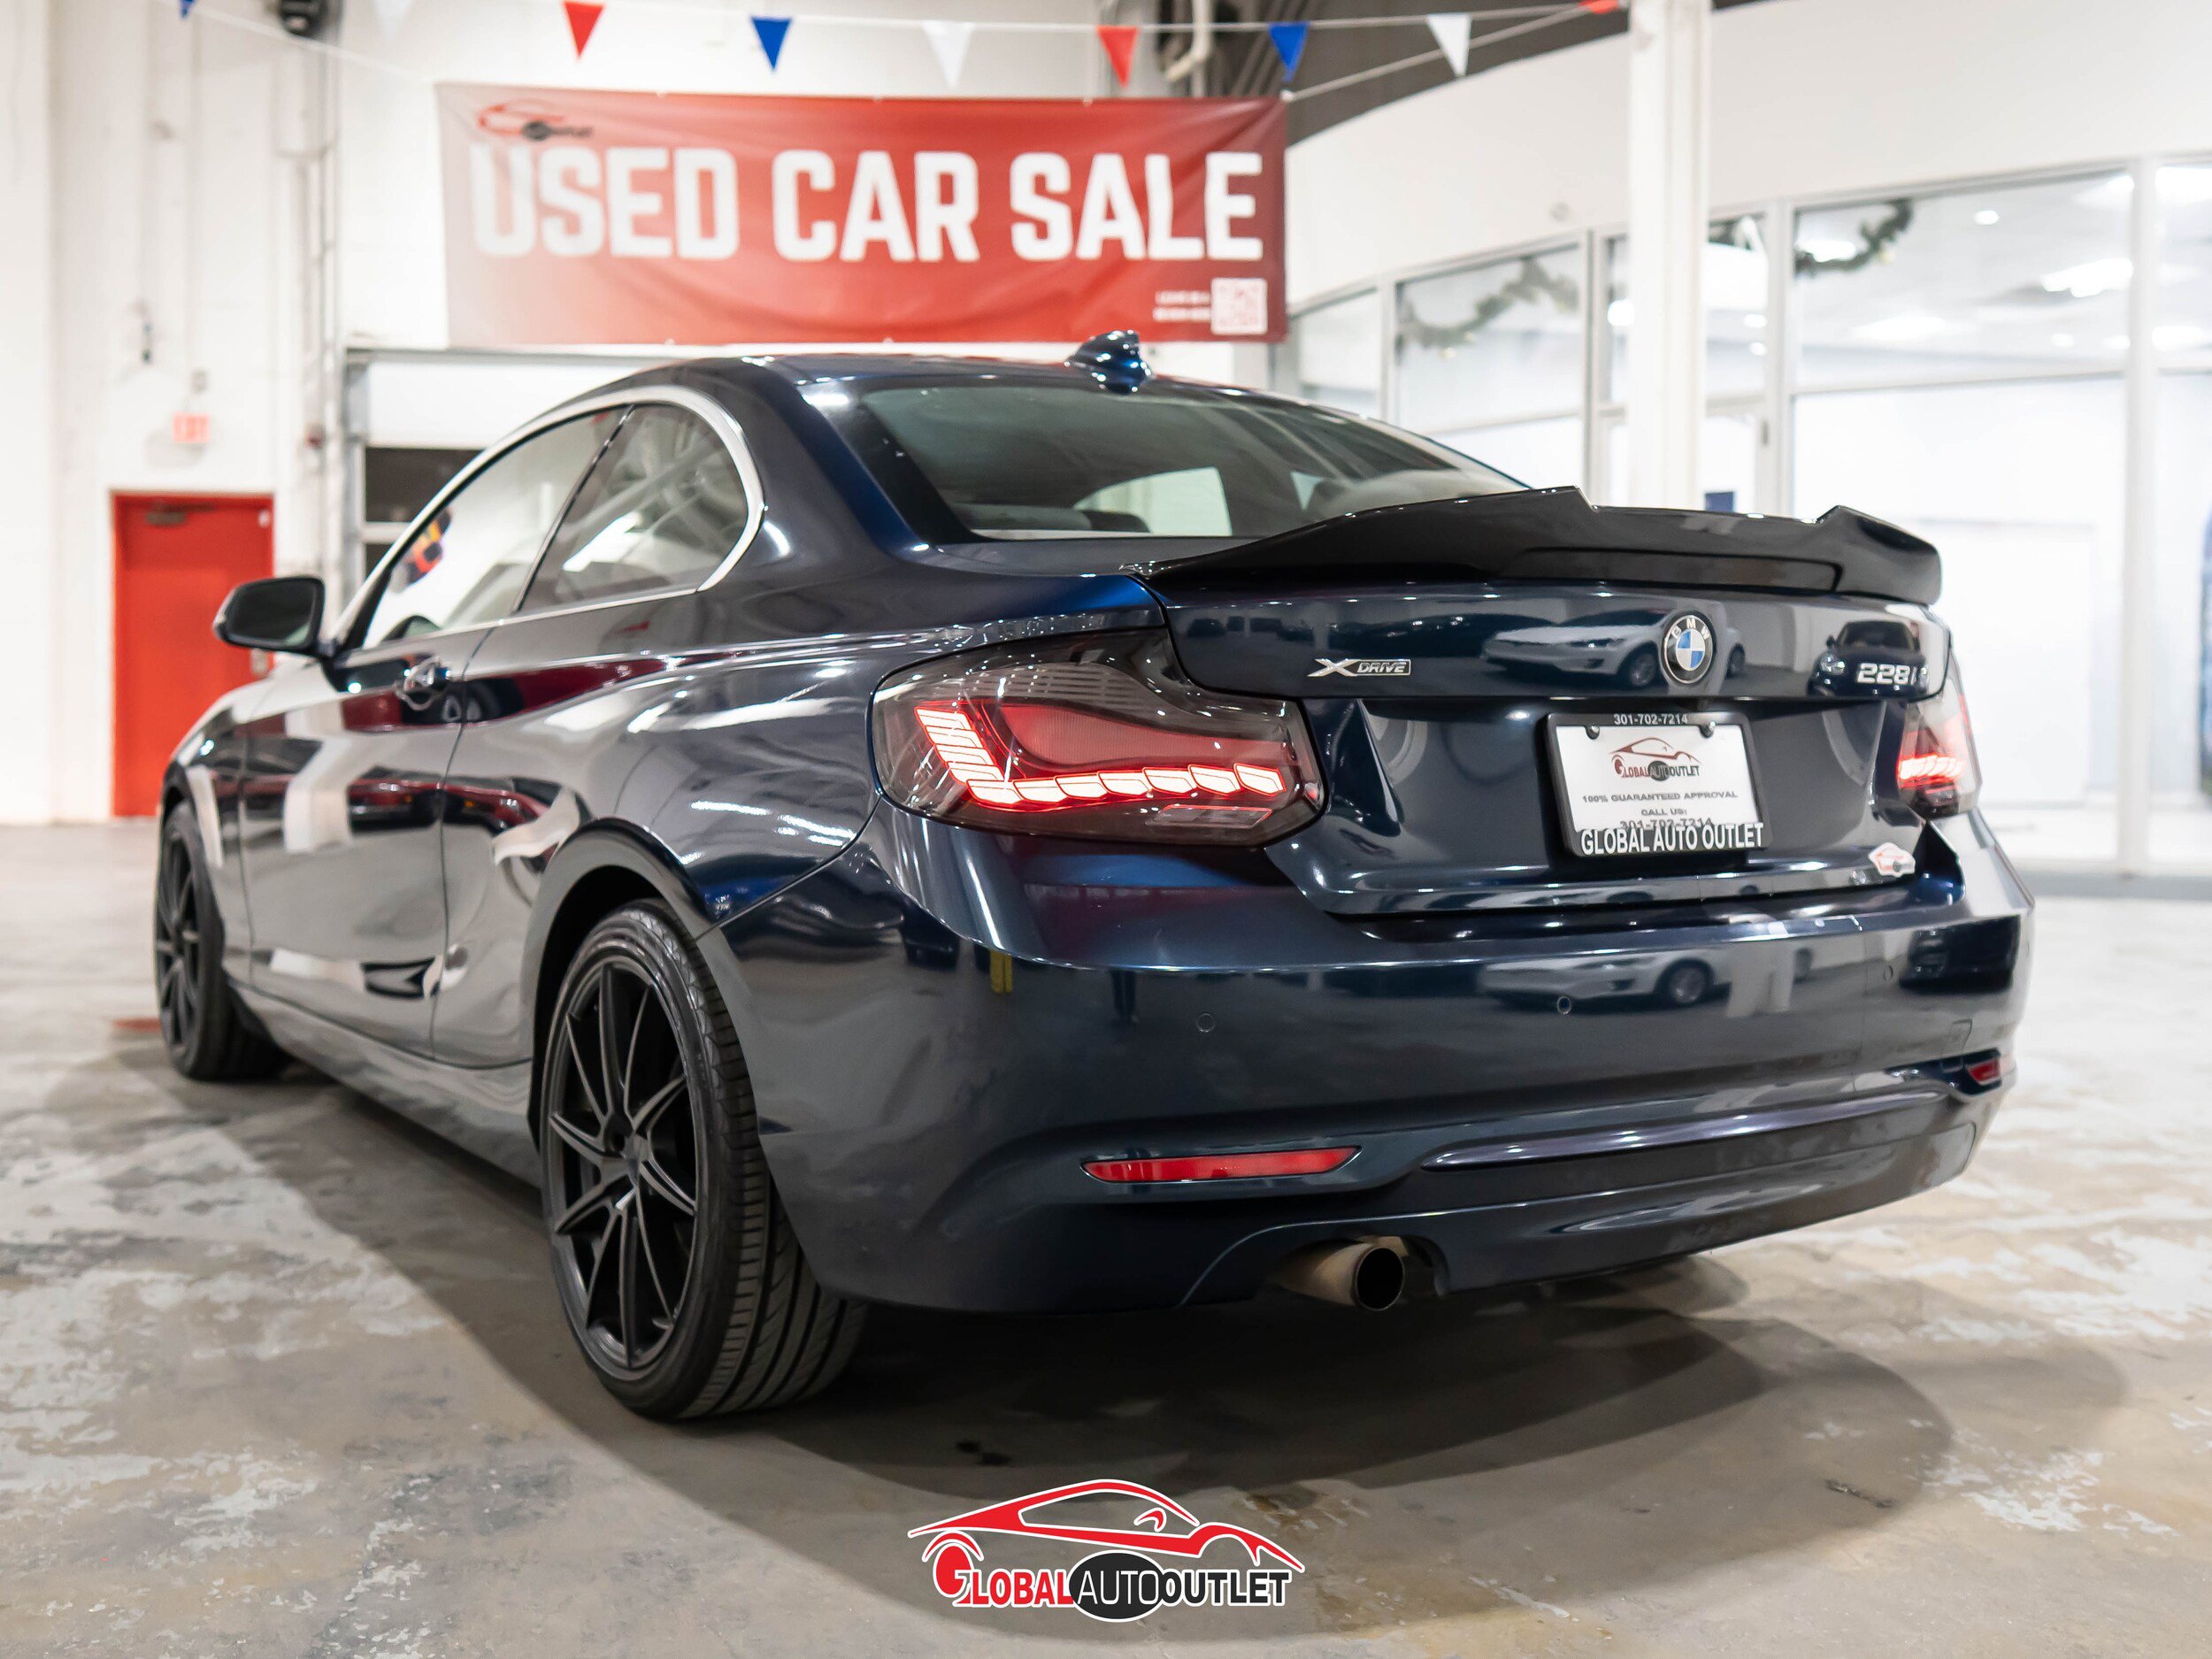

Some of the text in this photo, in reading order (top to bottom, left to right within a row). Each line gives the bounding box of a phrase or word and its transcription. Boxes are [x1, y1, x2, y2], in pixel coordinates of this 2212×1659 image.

[468, 143, 1264, 263] USED CAR SALE
[1671, 618, 1711, 640] BMW
[1613, 714, 1688, 726] 301-702-7214
[1611, 793, 1680, 802] GUARANTEED
[1580, 822, 1764, 856] GLOBAL AUTO OUTLET
